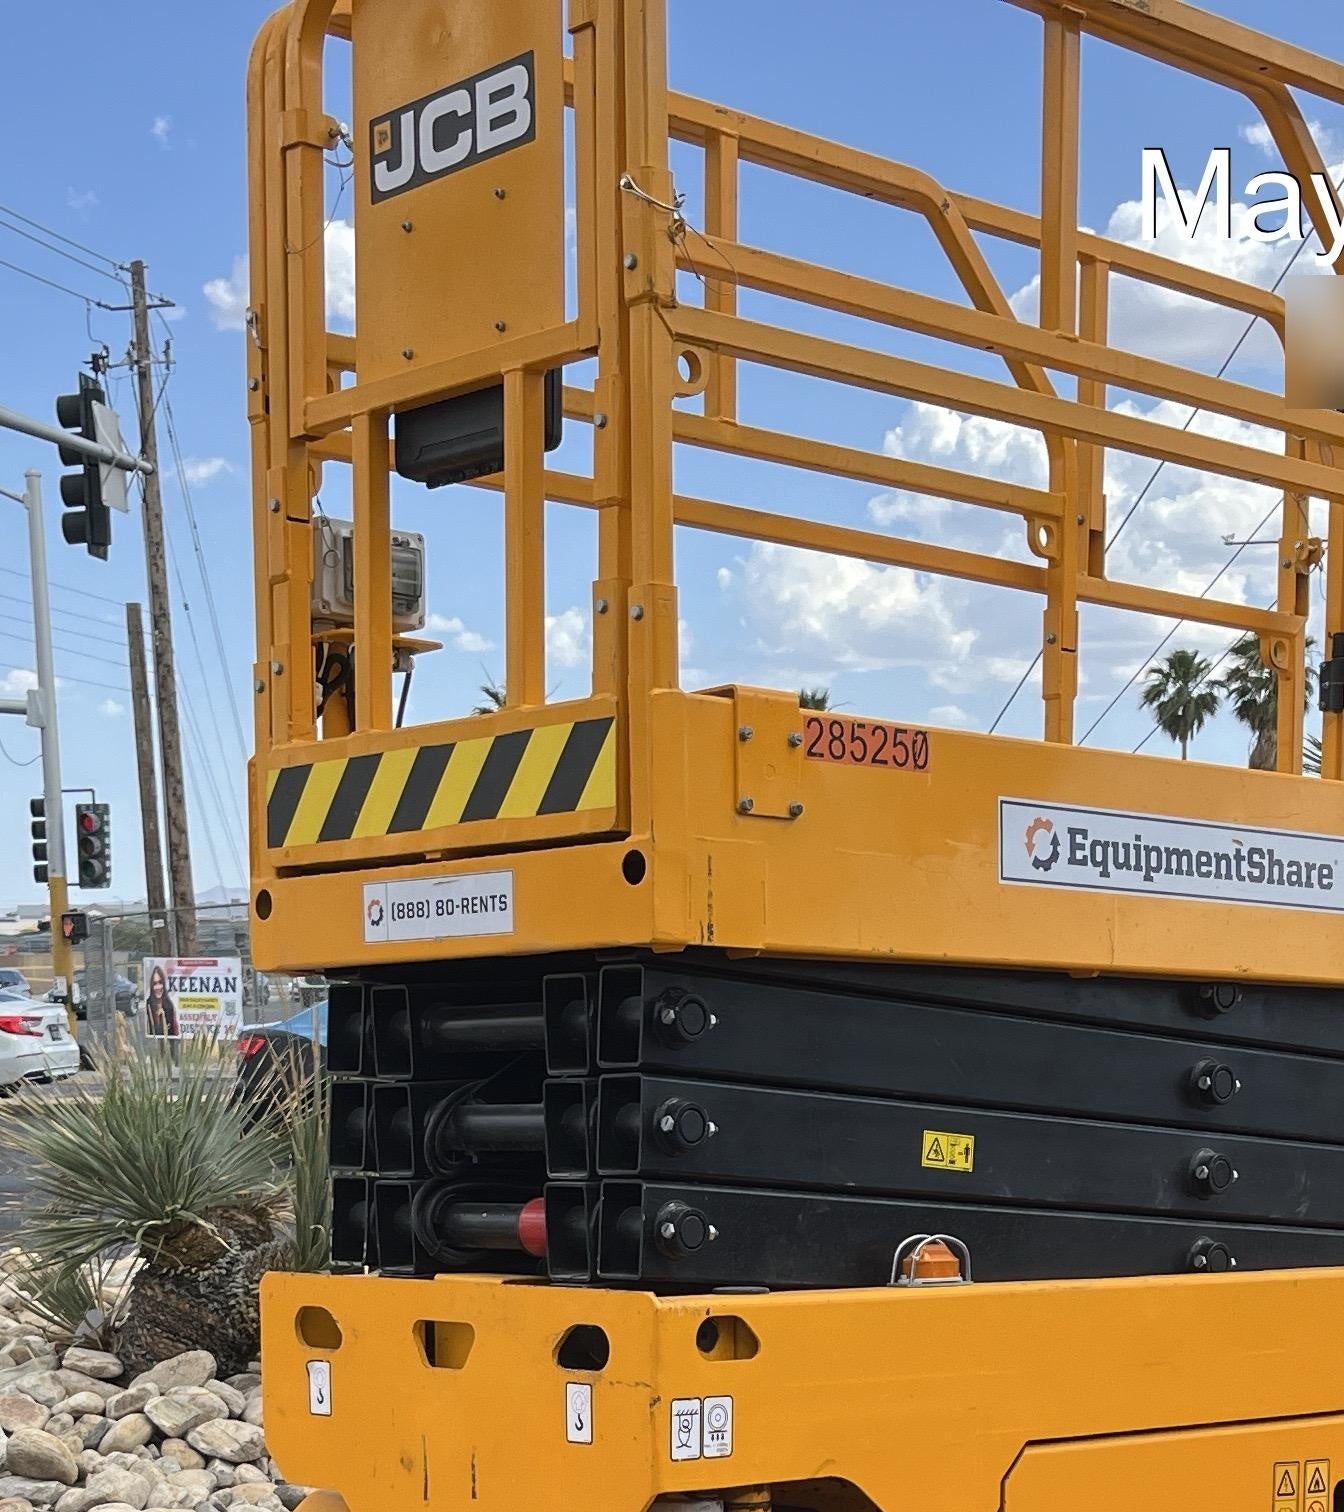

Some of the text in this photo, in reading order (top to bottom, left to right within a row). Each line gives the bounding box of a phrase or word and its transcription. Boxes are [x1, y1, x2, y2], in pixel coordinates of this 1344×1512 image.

[374, 64, 531, 192] JCB
[806, 717, 929, 770] 285250
[1067, 826, 1334, 890] EquipmentShare
[391, 894, 508, 921] (888) 80-RENTS
[167, 976, 237, 993] KEENAN
